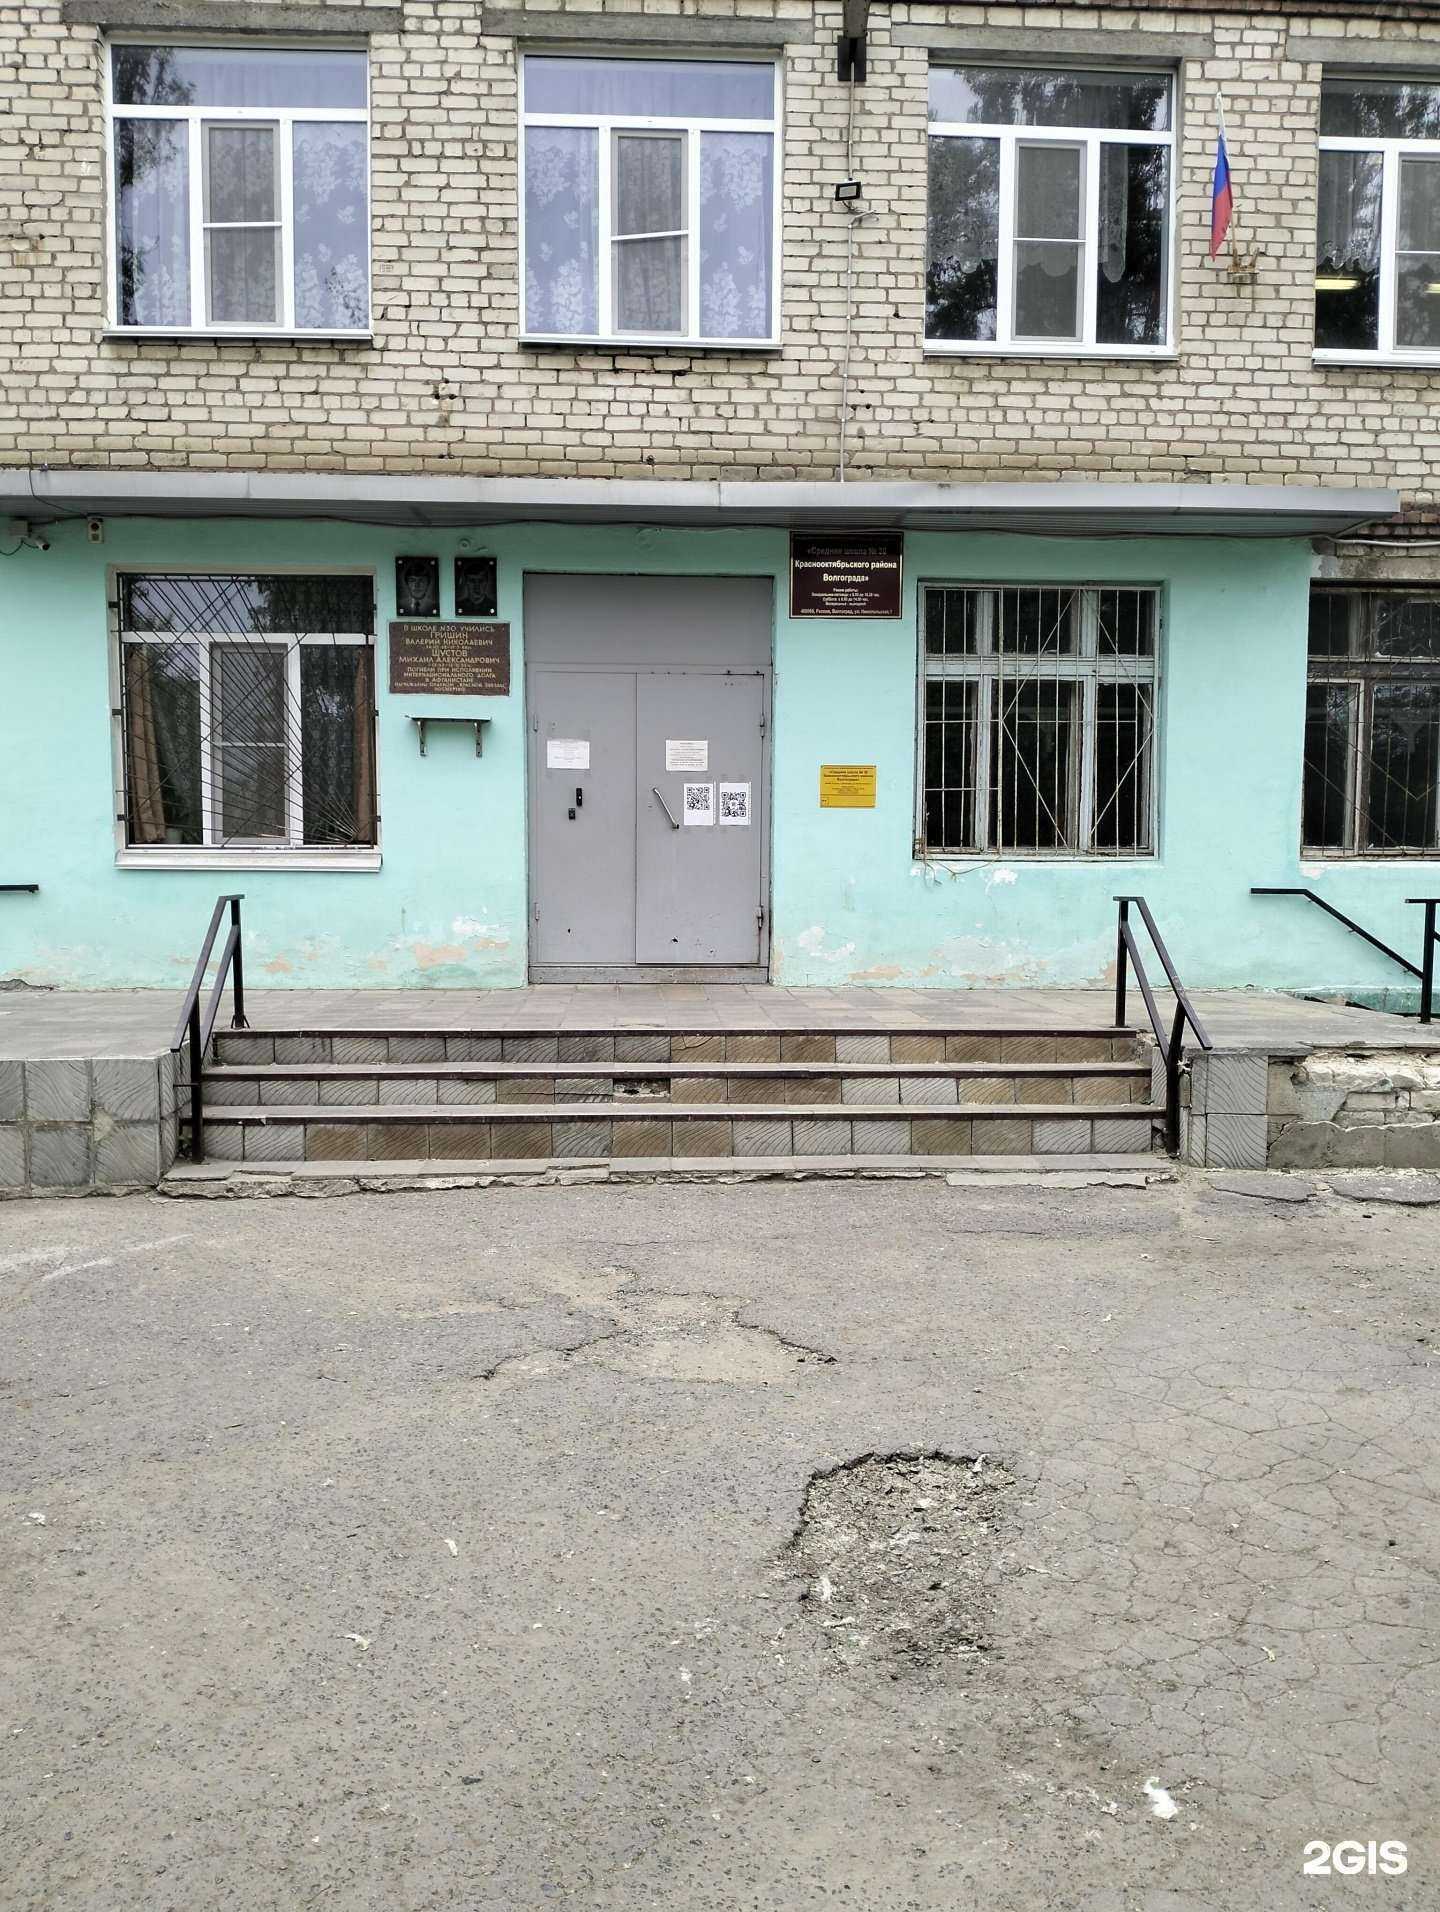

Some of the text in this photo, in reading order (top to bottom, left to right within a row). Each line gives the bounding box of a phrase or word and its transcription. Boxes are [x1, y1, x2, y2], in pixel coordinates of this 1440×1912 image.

[795, 560, 897, 570] Краснооктябрьского района
[823, 573, 869, 583] Волгограда»
